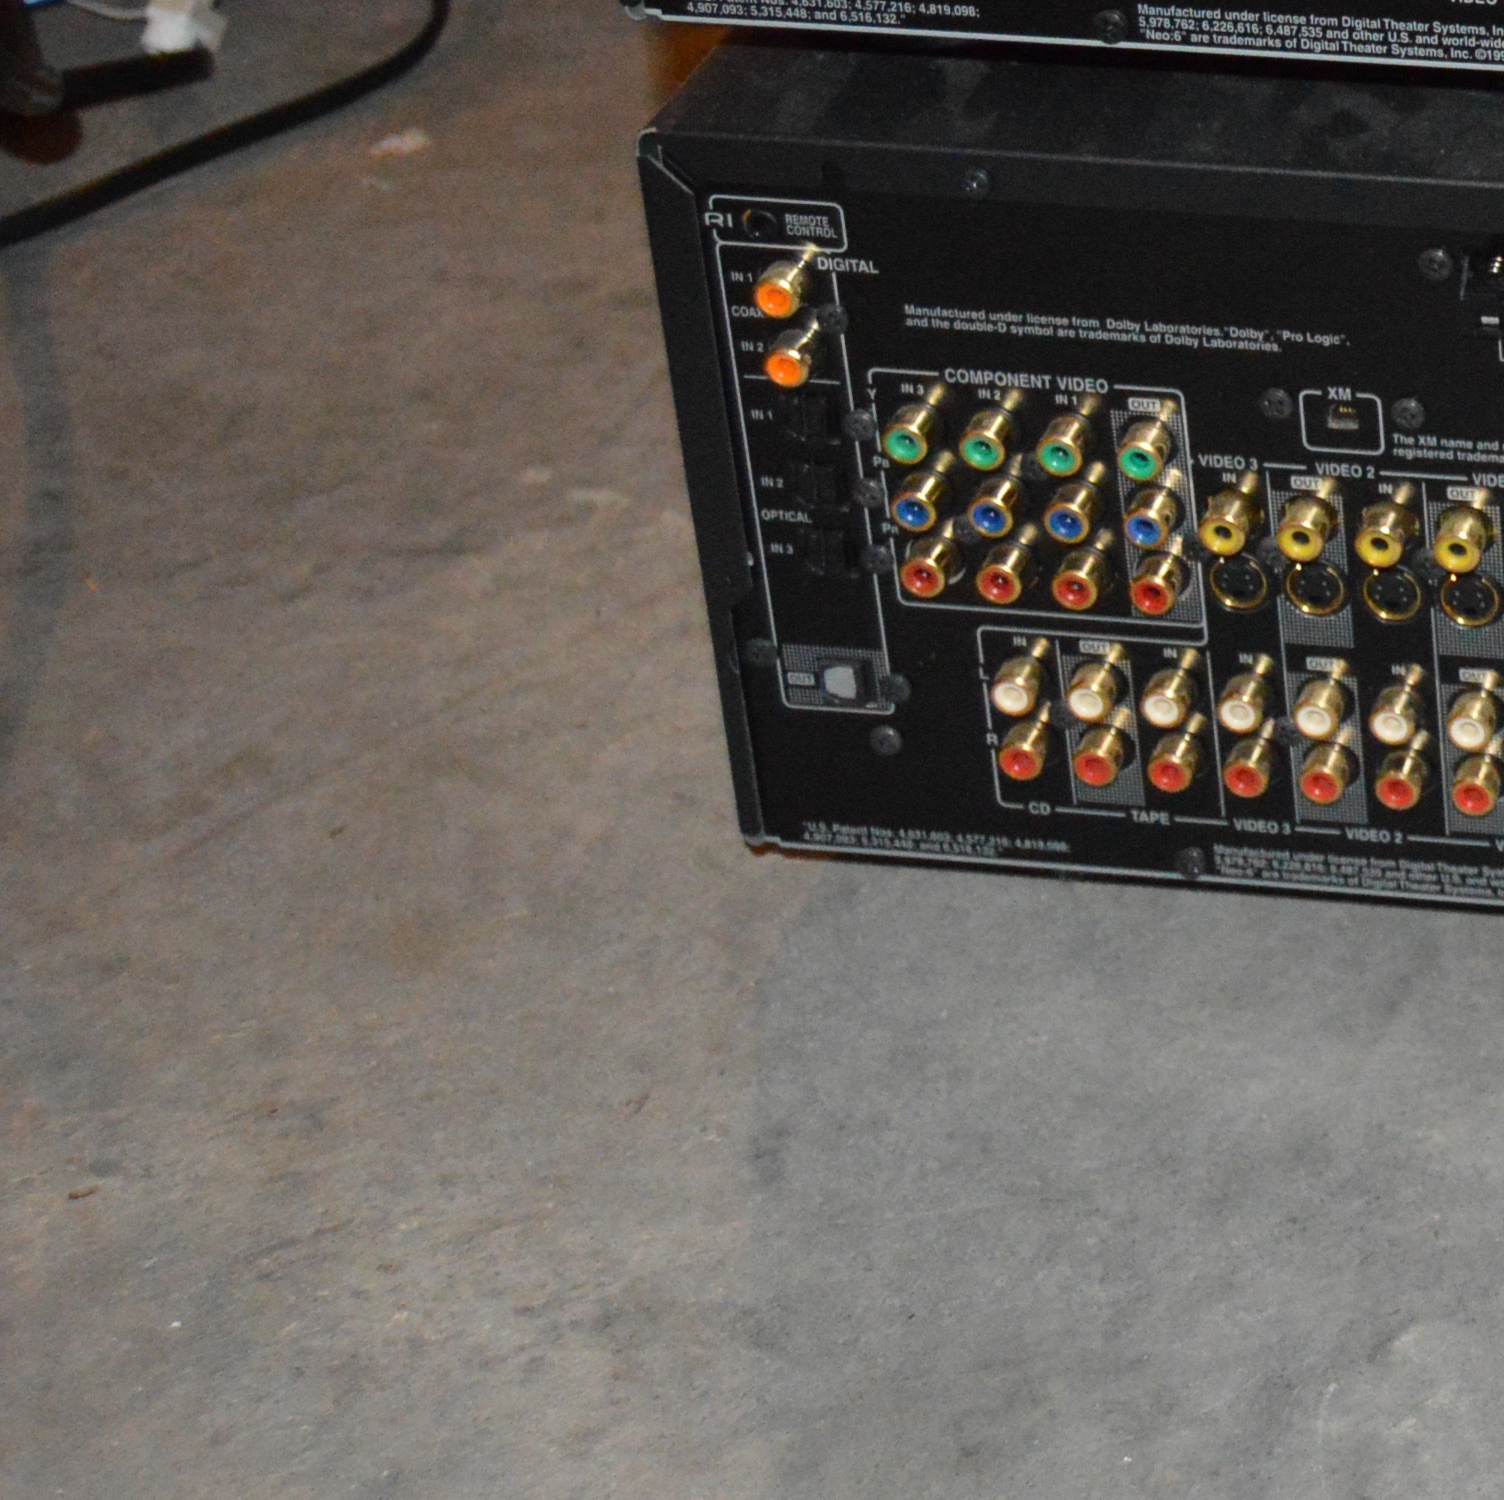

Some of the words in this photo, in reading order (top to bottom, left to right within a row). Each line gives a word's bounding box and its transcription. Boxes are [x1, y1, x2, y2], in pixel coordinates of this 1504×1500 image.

[817, 256, 878, 274] DIGITAL
[943, 367, 1051, 390] COMPONENT
[1056, 375, 1109, 394] VIDEO
